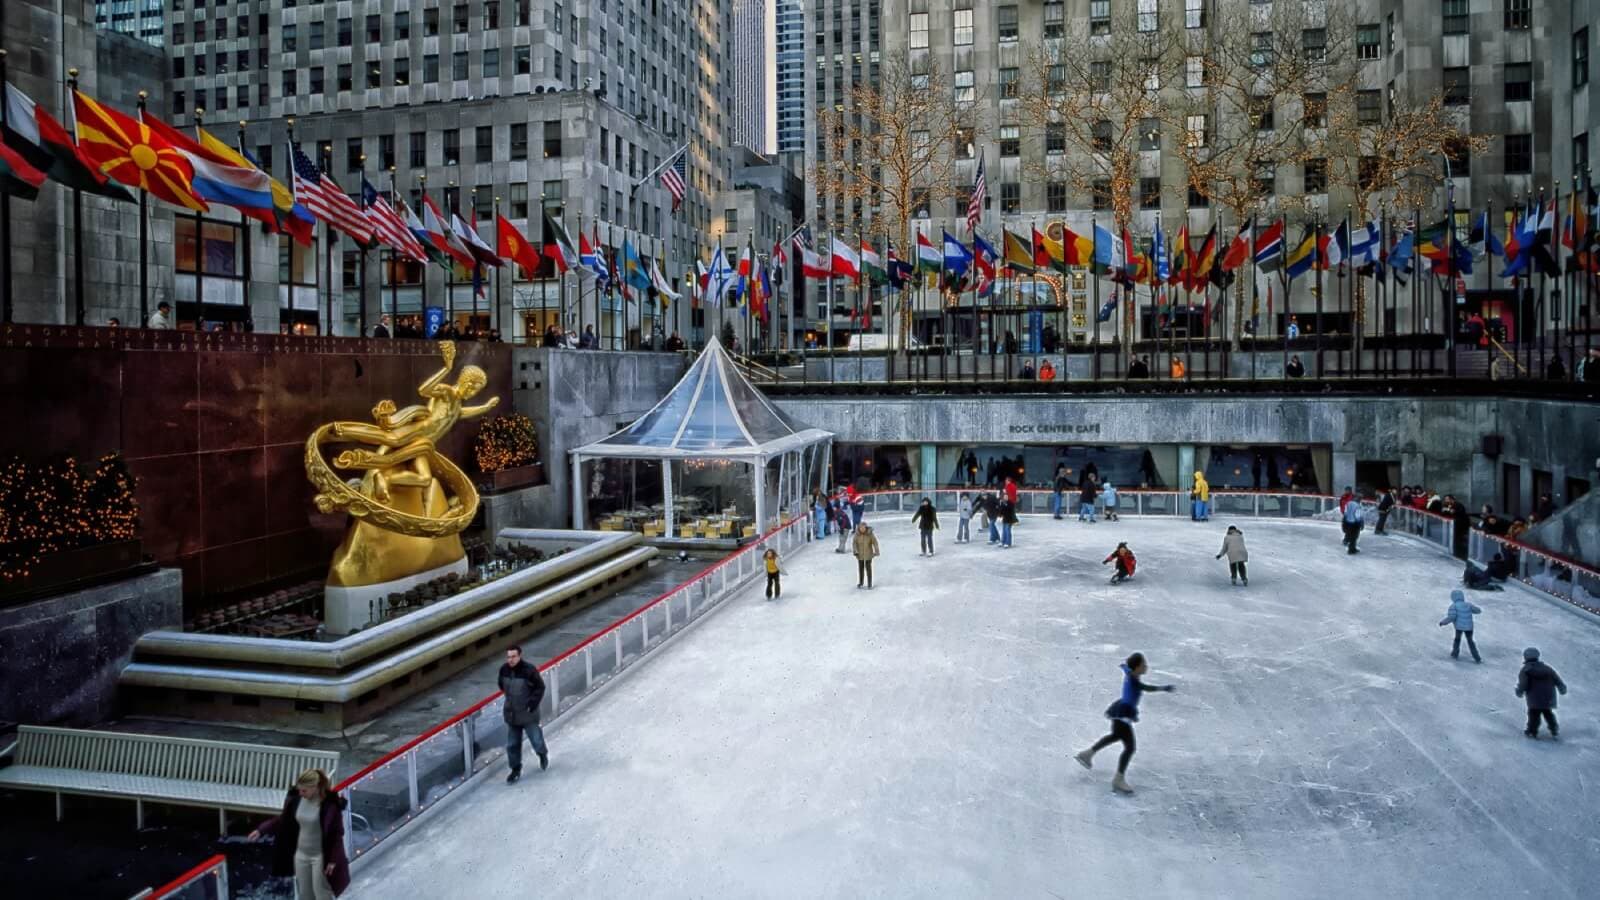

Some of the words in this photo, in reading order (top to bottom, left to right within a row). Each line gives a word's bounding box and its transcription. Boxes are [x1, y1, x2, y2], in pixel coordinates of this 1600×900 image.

[6, 326, 160, 340] PROMETHEUS
[1009, 425, 1034, 433] ROCK
[1037, 425, 1073, 433] CENTER
